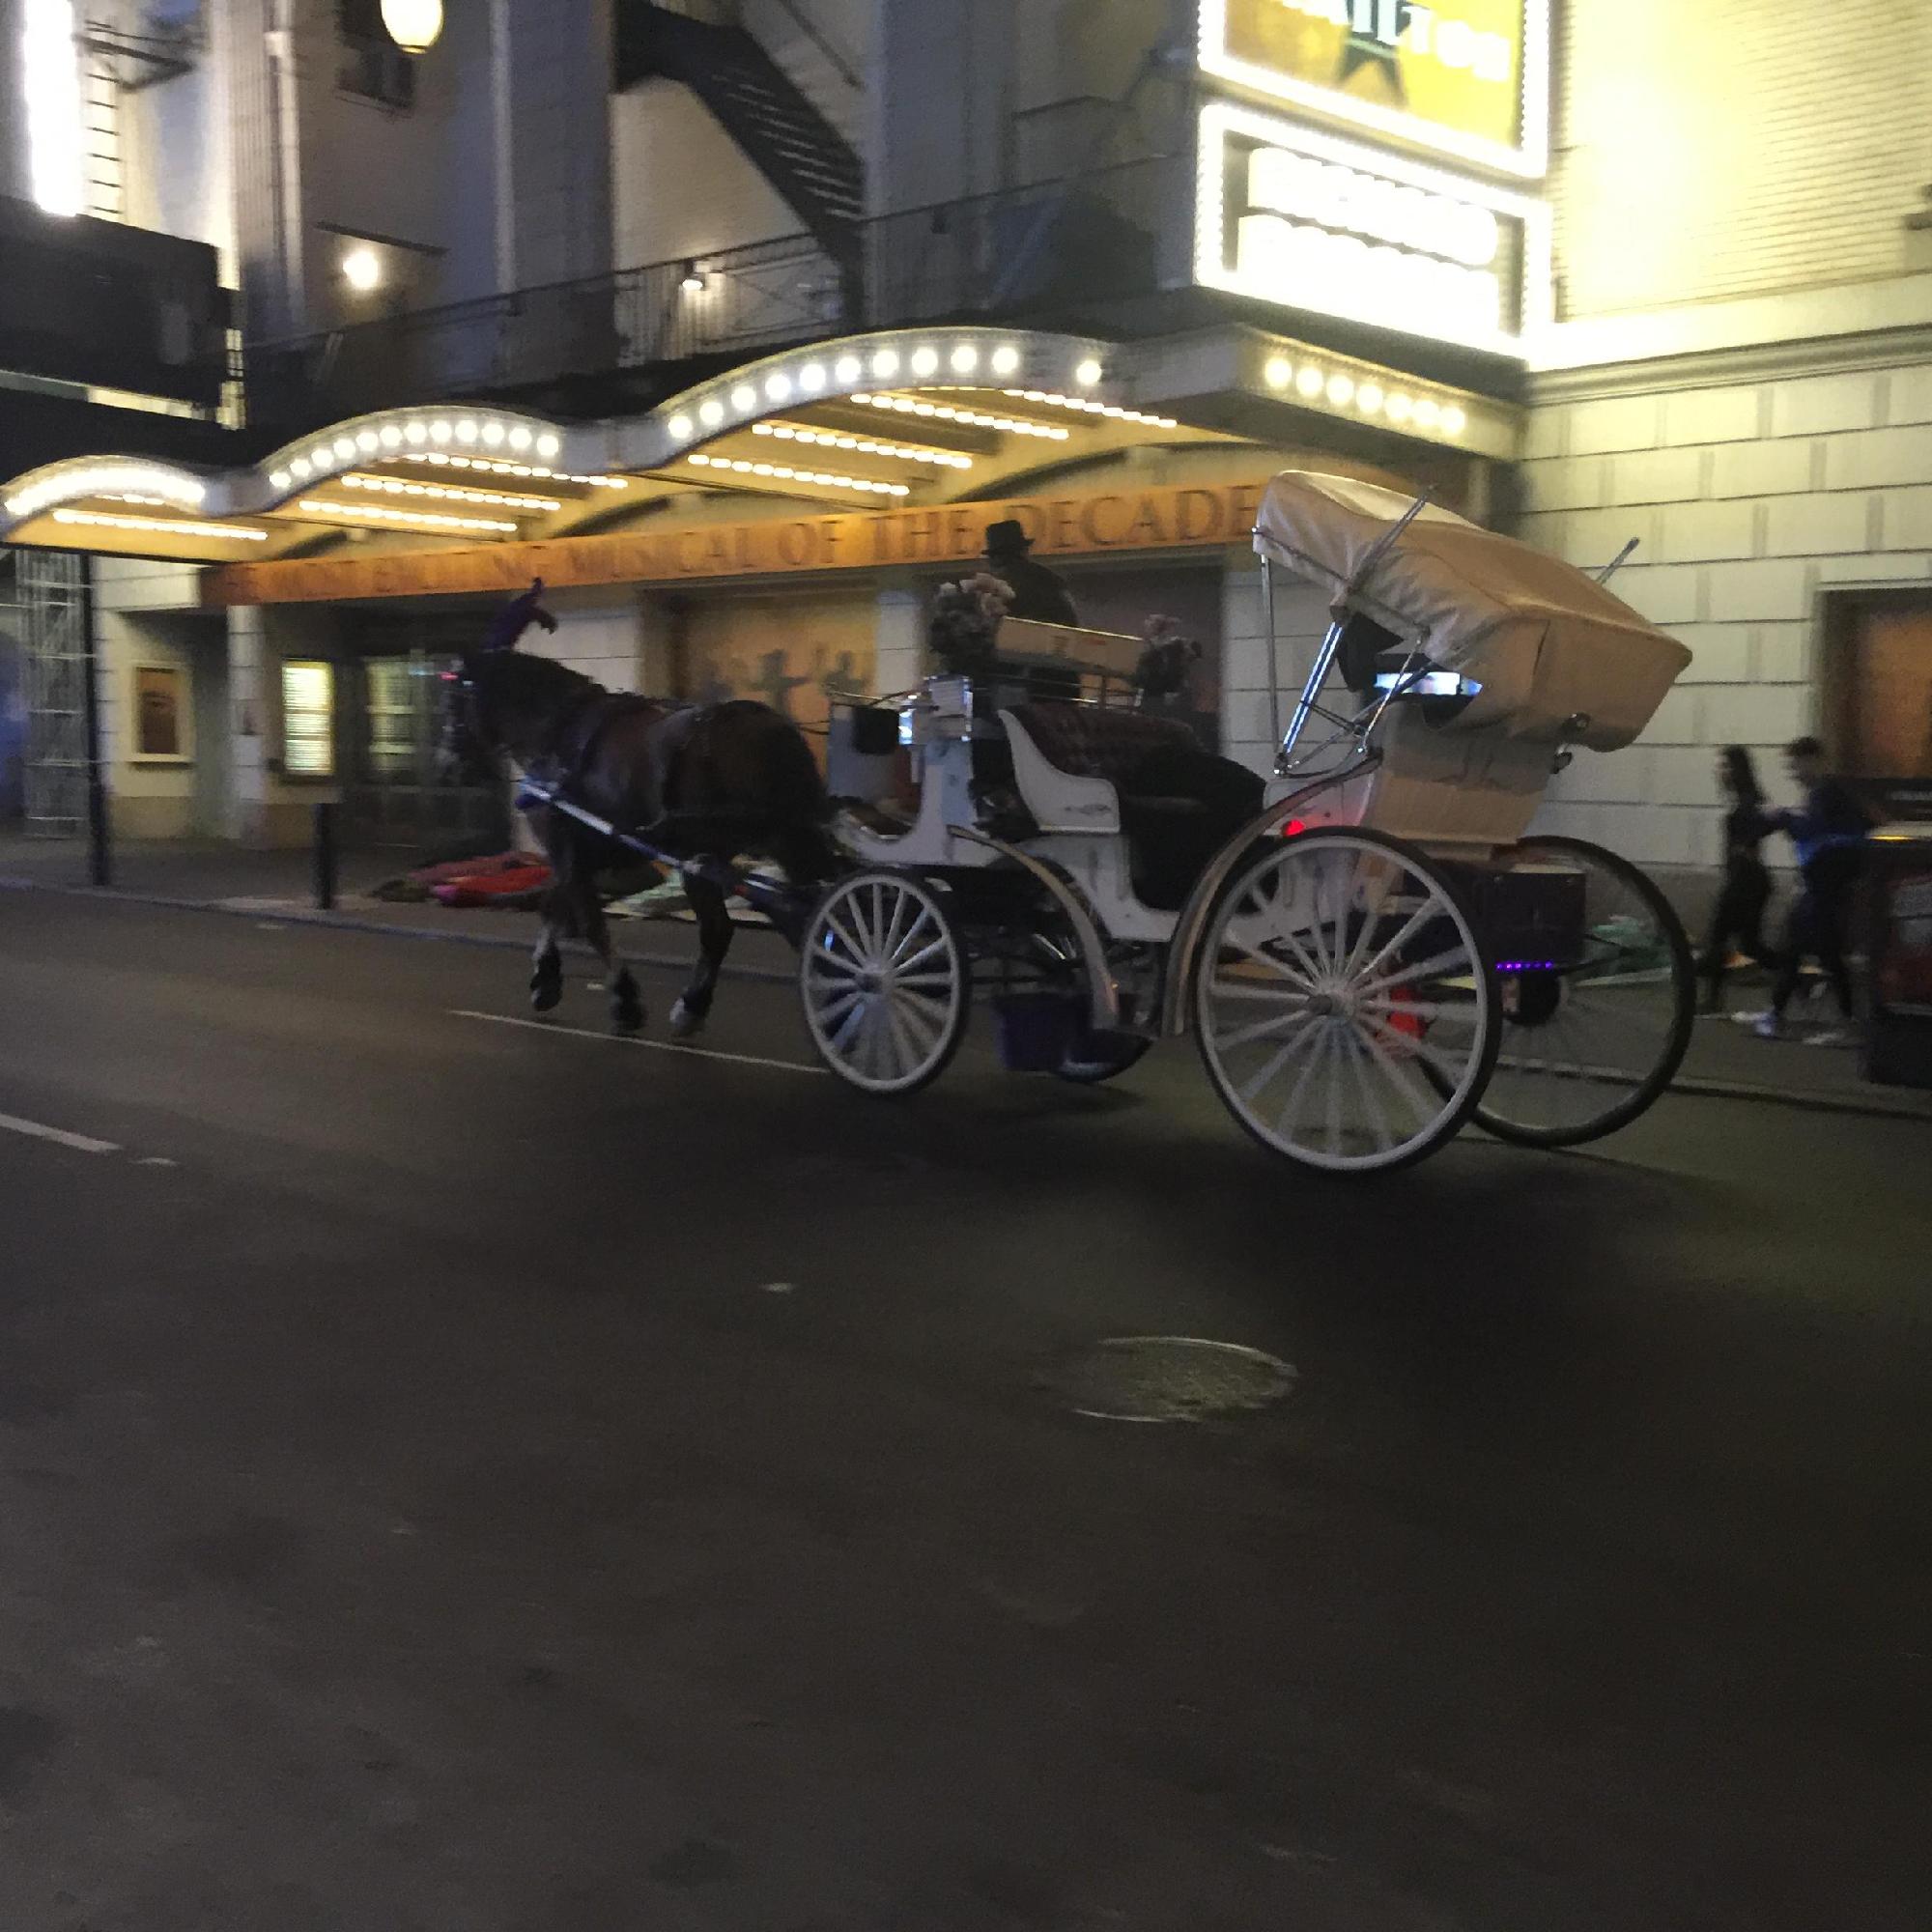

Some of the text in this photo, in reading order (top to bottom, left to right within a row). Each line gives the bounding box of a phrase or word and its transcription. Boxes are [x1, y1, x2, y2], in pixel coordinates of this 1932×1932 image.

[777, 519, 843, 566] OF
[867, 508, 981, 560] THE
[1005, 484, 1261, 550] DECADE
